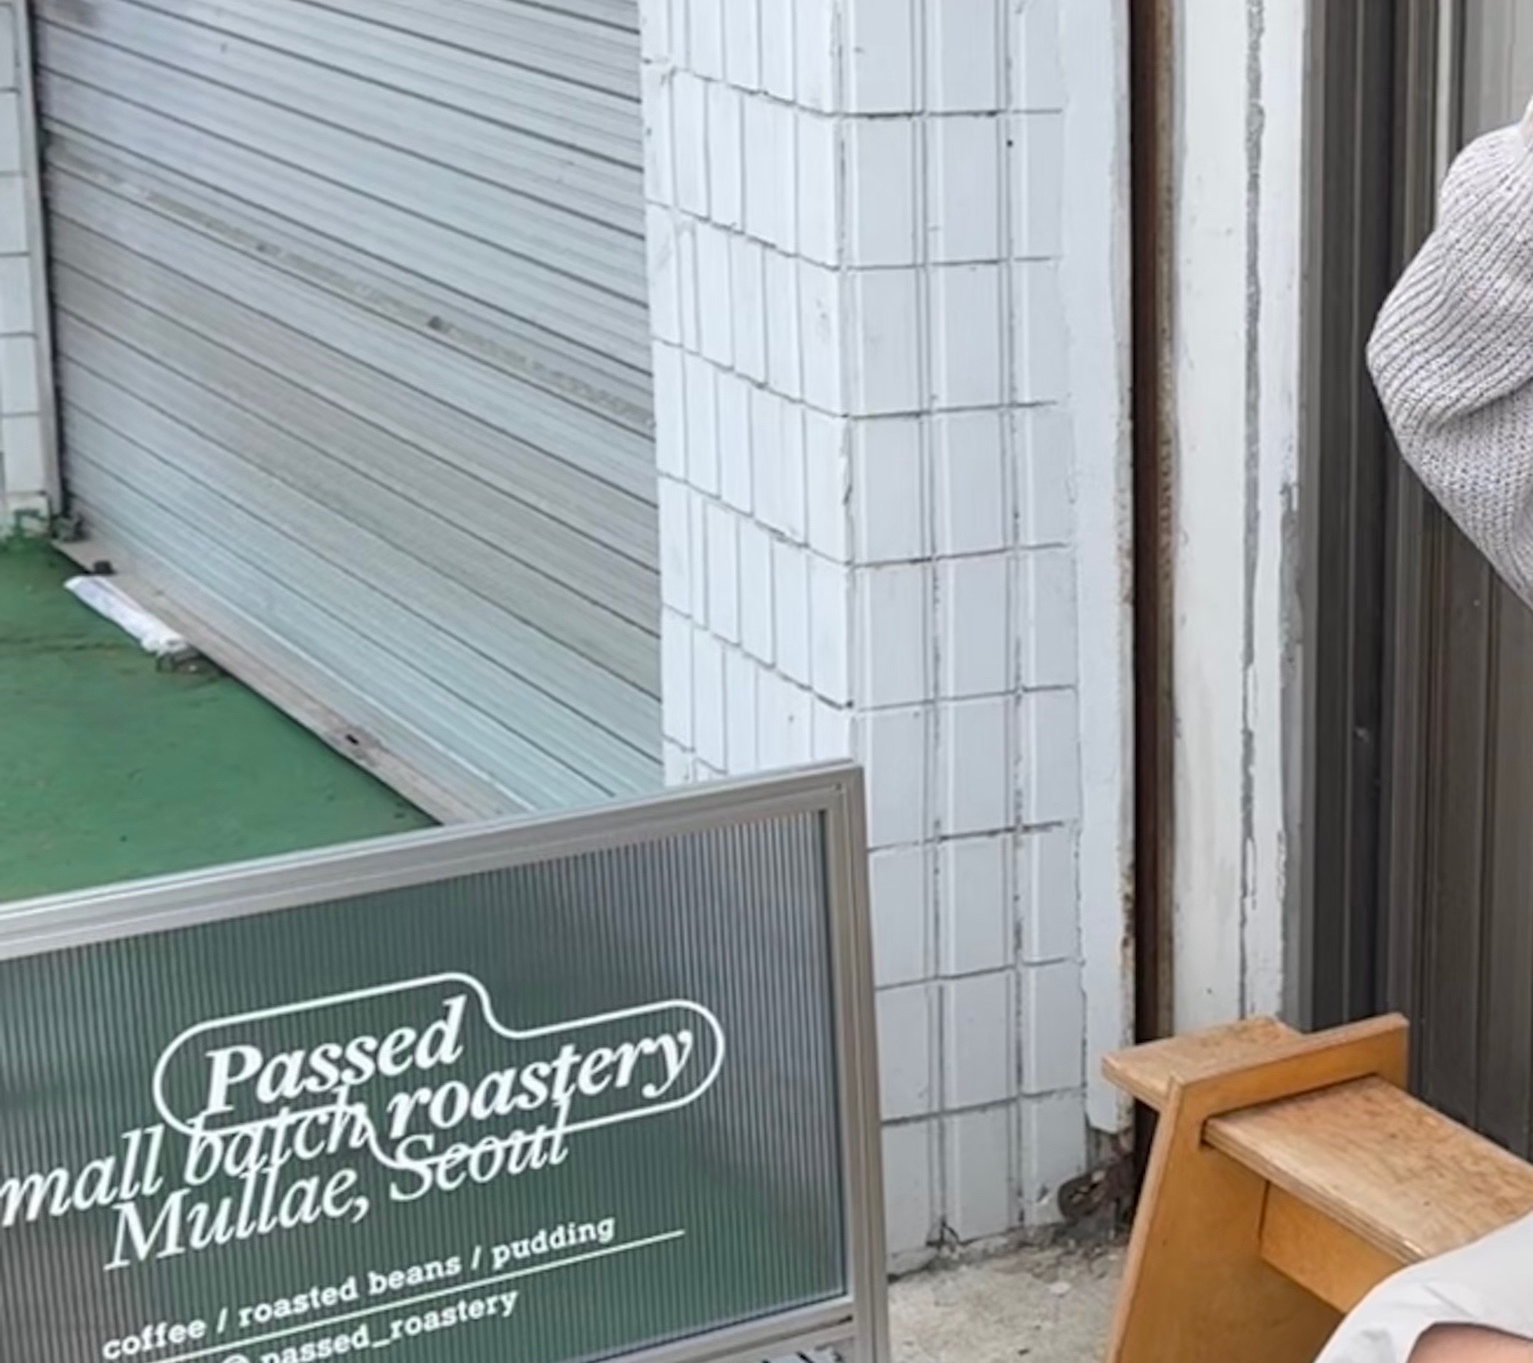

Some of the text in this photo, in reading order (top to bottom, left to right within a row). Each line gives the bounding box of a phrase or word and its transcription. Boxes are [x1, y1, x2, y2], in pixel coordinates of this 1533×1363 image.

[205, 994, 468, 1116] Passed
[386, 1029, 694, 1139] roastery
[103, 1100, 569, 1271] Mullae, Seoul
[184, 1084, 372, 1186] batch
[102, 1318, 207, 1360] coffee
[238, 1275, 359, 1327] roasted
[367, 1255, 462, 1296] beans
[491, 1216, 616, 1270] pudding
